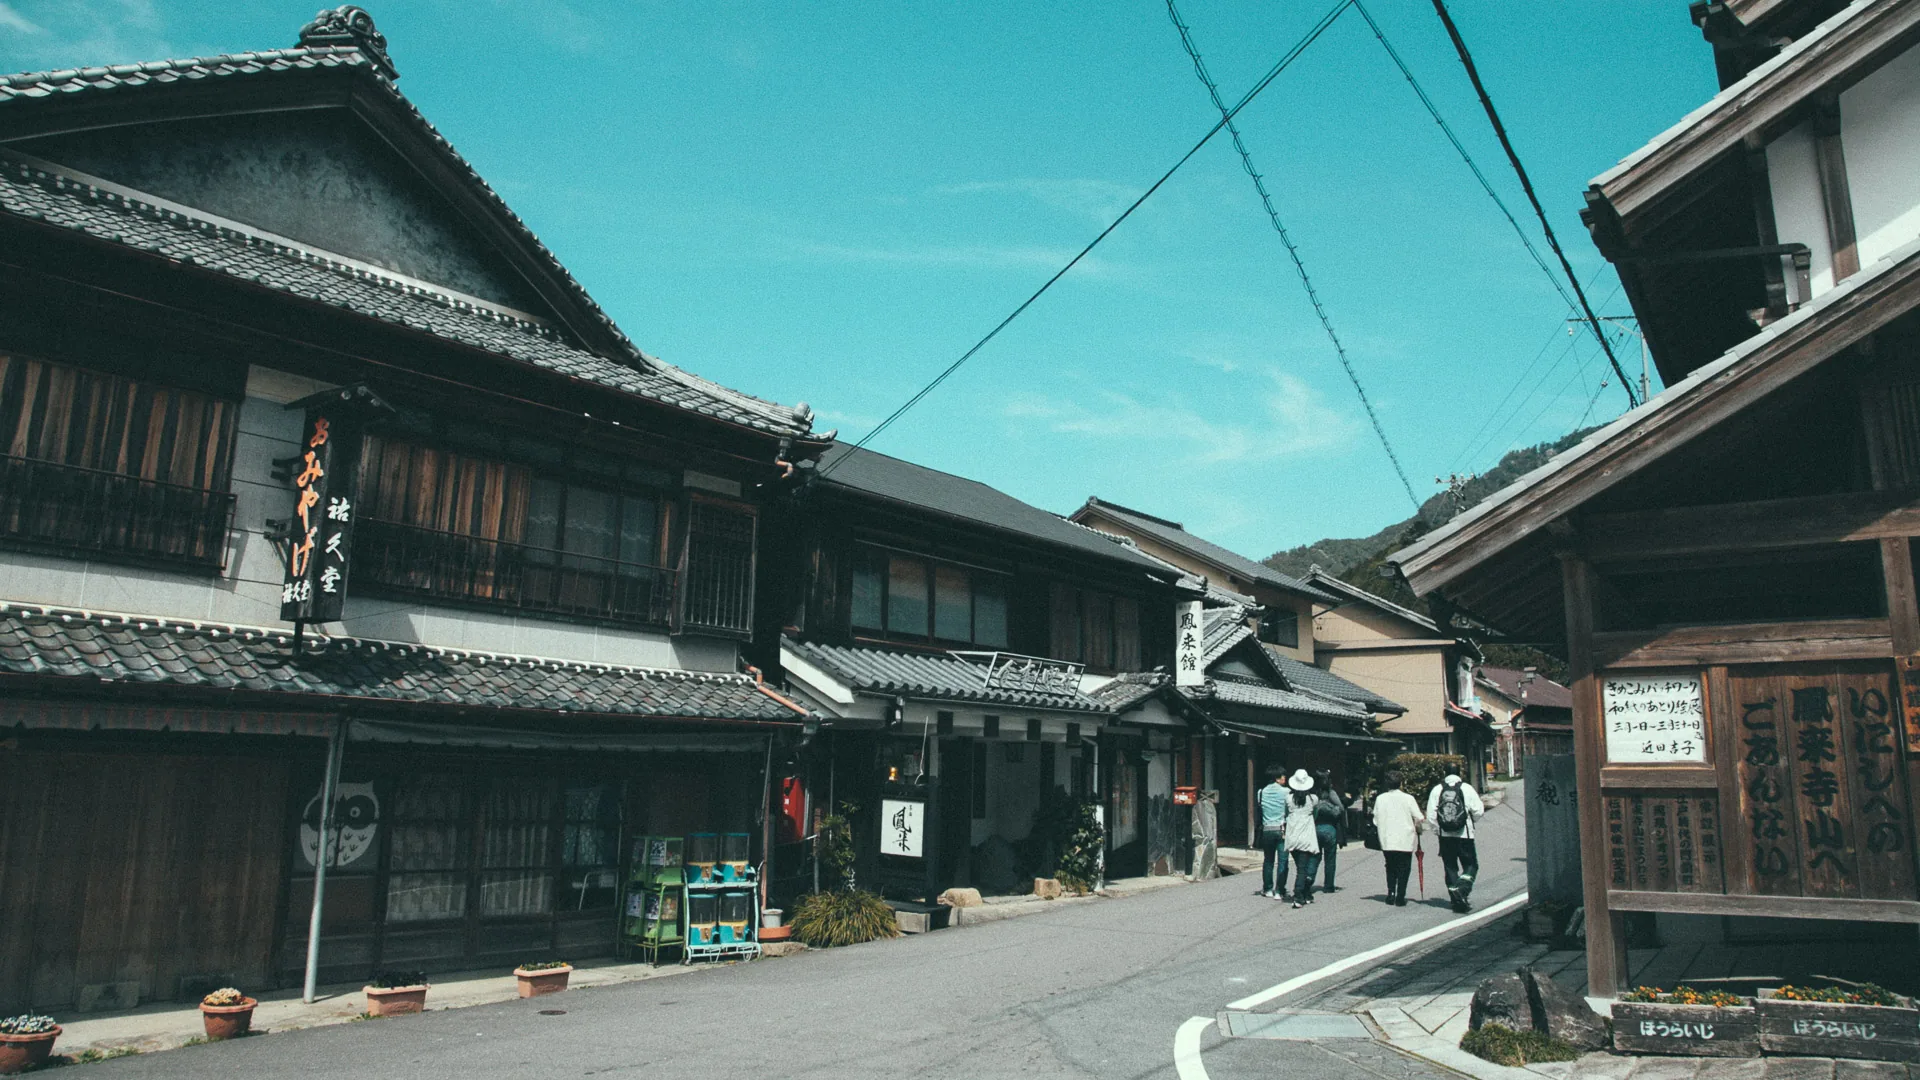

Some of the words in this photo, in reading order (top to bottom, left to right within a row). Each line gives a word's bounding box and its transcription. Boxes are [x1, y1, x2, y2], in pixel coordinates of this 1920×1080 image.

[292, 416, 330, 578] おみやげ
[320, 496, 351, 593] 祐久堂
[1179, 612, 1198, 672] 鳳来館
[1741, 696, 1789, 876] ごあんない
[1791, 686, 1850, 874] 鳳来寺山へ
[1847, 687, 1905, 854] いにしへの
[1640, 1020, 1715, 1040] ほうらいじ
[1793, 1018, 1877, 1041] ほうらいじ
